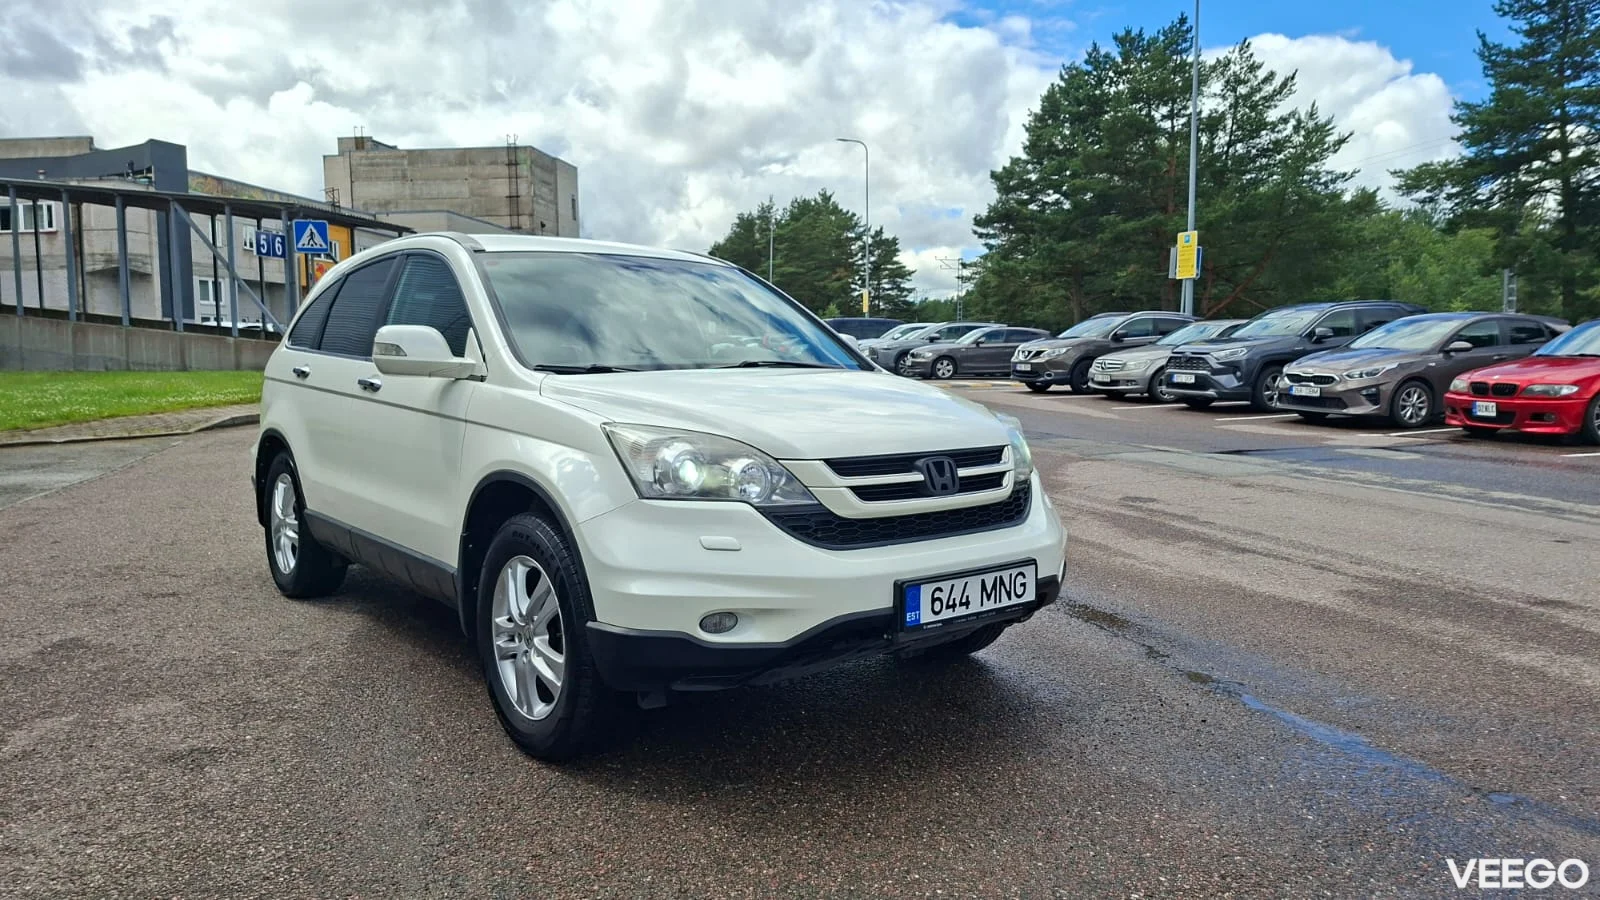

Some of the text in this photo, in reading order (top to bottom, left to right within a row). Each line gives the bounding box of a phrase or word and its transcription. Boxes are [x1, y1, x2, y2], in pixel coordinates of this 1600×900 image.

[260, 234, 282, 255] 5 6
[930, 571, 1027, 616] 644 MNG
[906, 610, 920, 622] EST
